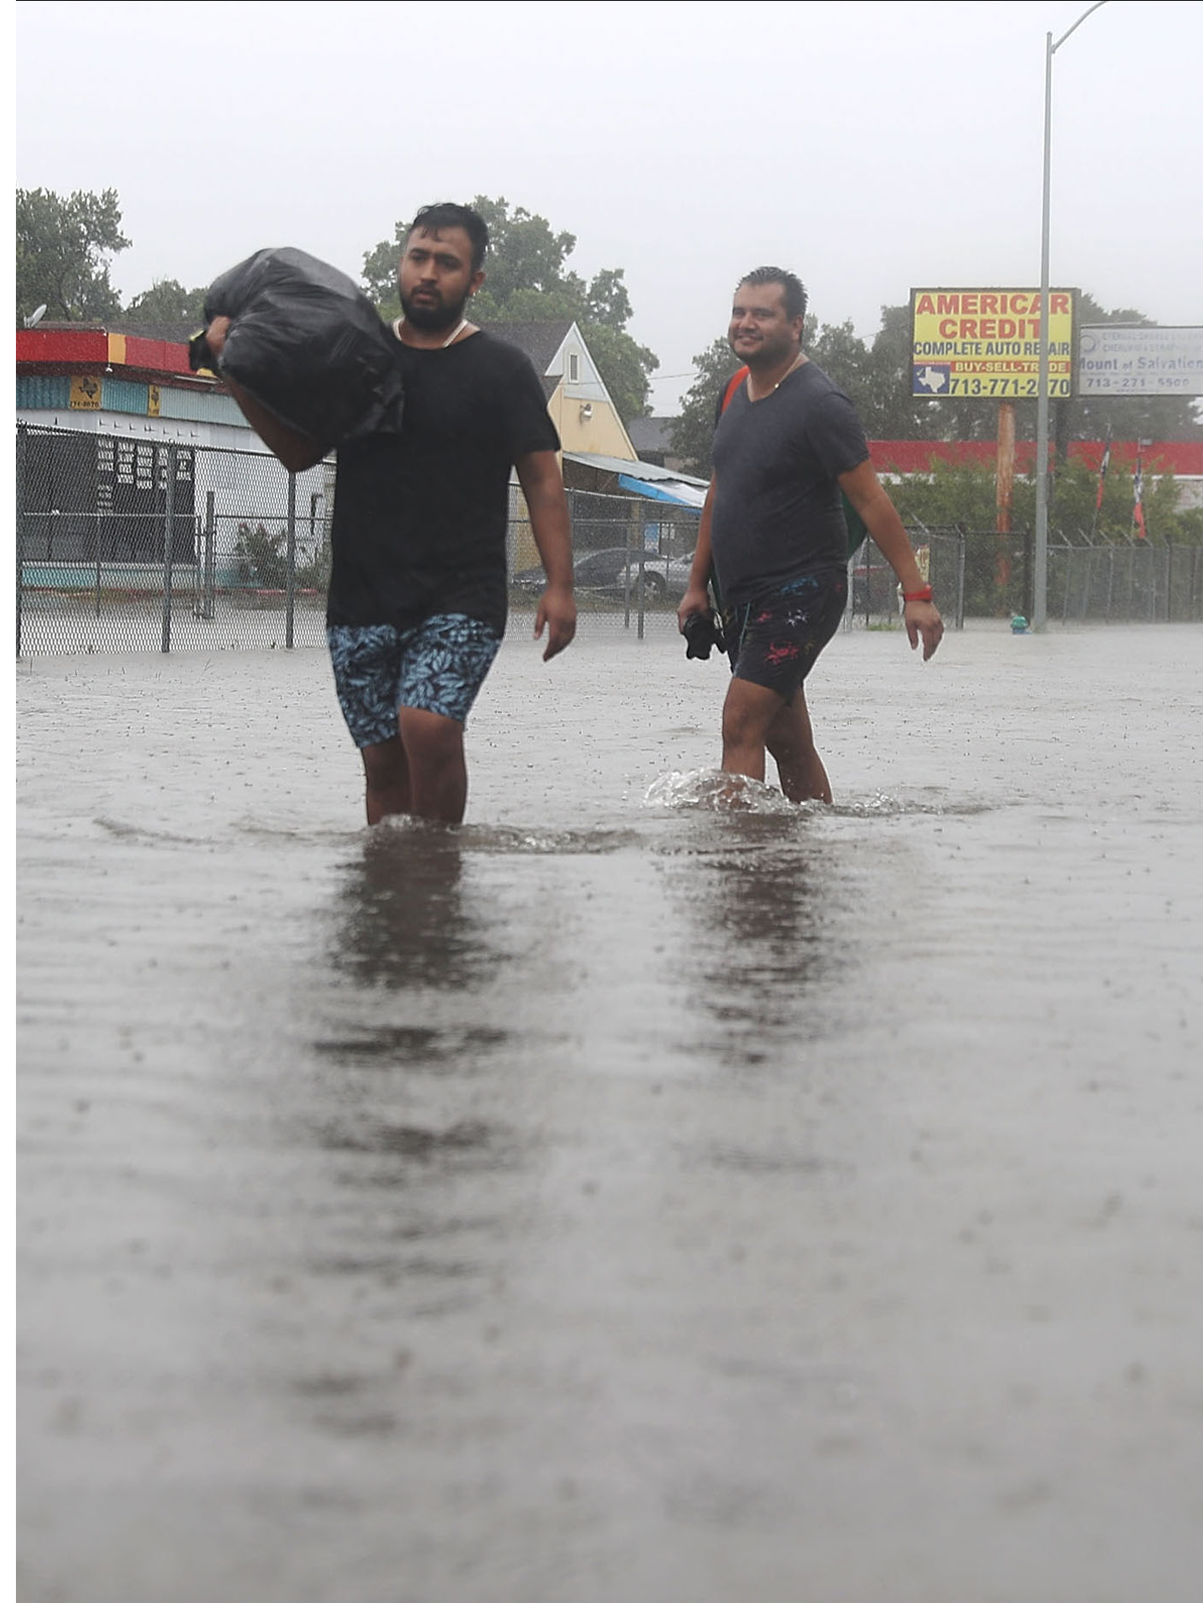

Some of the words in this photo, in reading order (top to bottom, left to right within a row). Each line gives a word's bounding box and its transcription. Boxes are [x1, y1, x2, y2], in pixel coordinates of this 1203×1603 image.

[939, 319, 1042, 339] CREDIT
[914, 341, 983, 355] COMPLETE
[986, 341, 1021, 355] AUTO
[1023, 341, 1070, 356] REAIR
[955, 362, 1067, 373] BUY-SELL-TRDE
[950, 378, 1070, 395] 713-771-270
